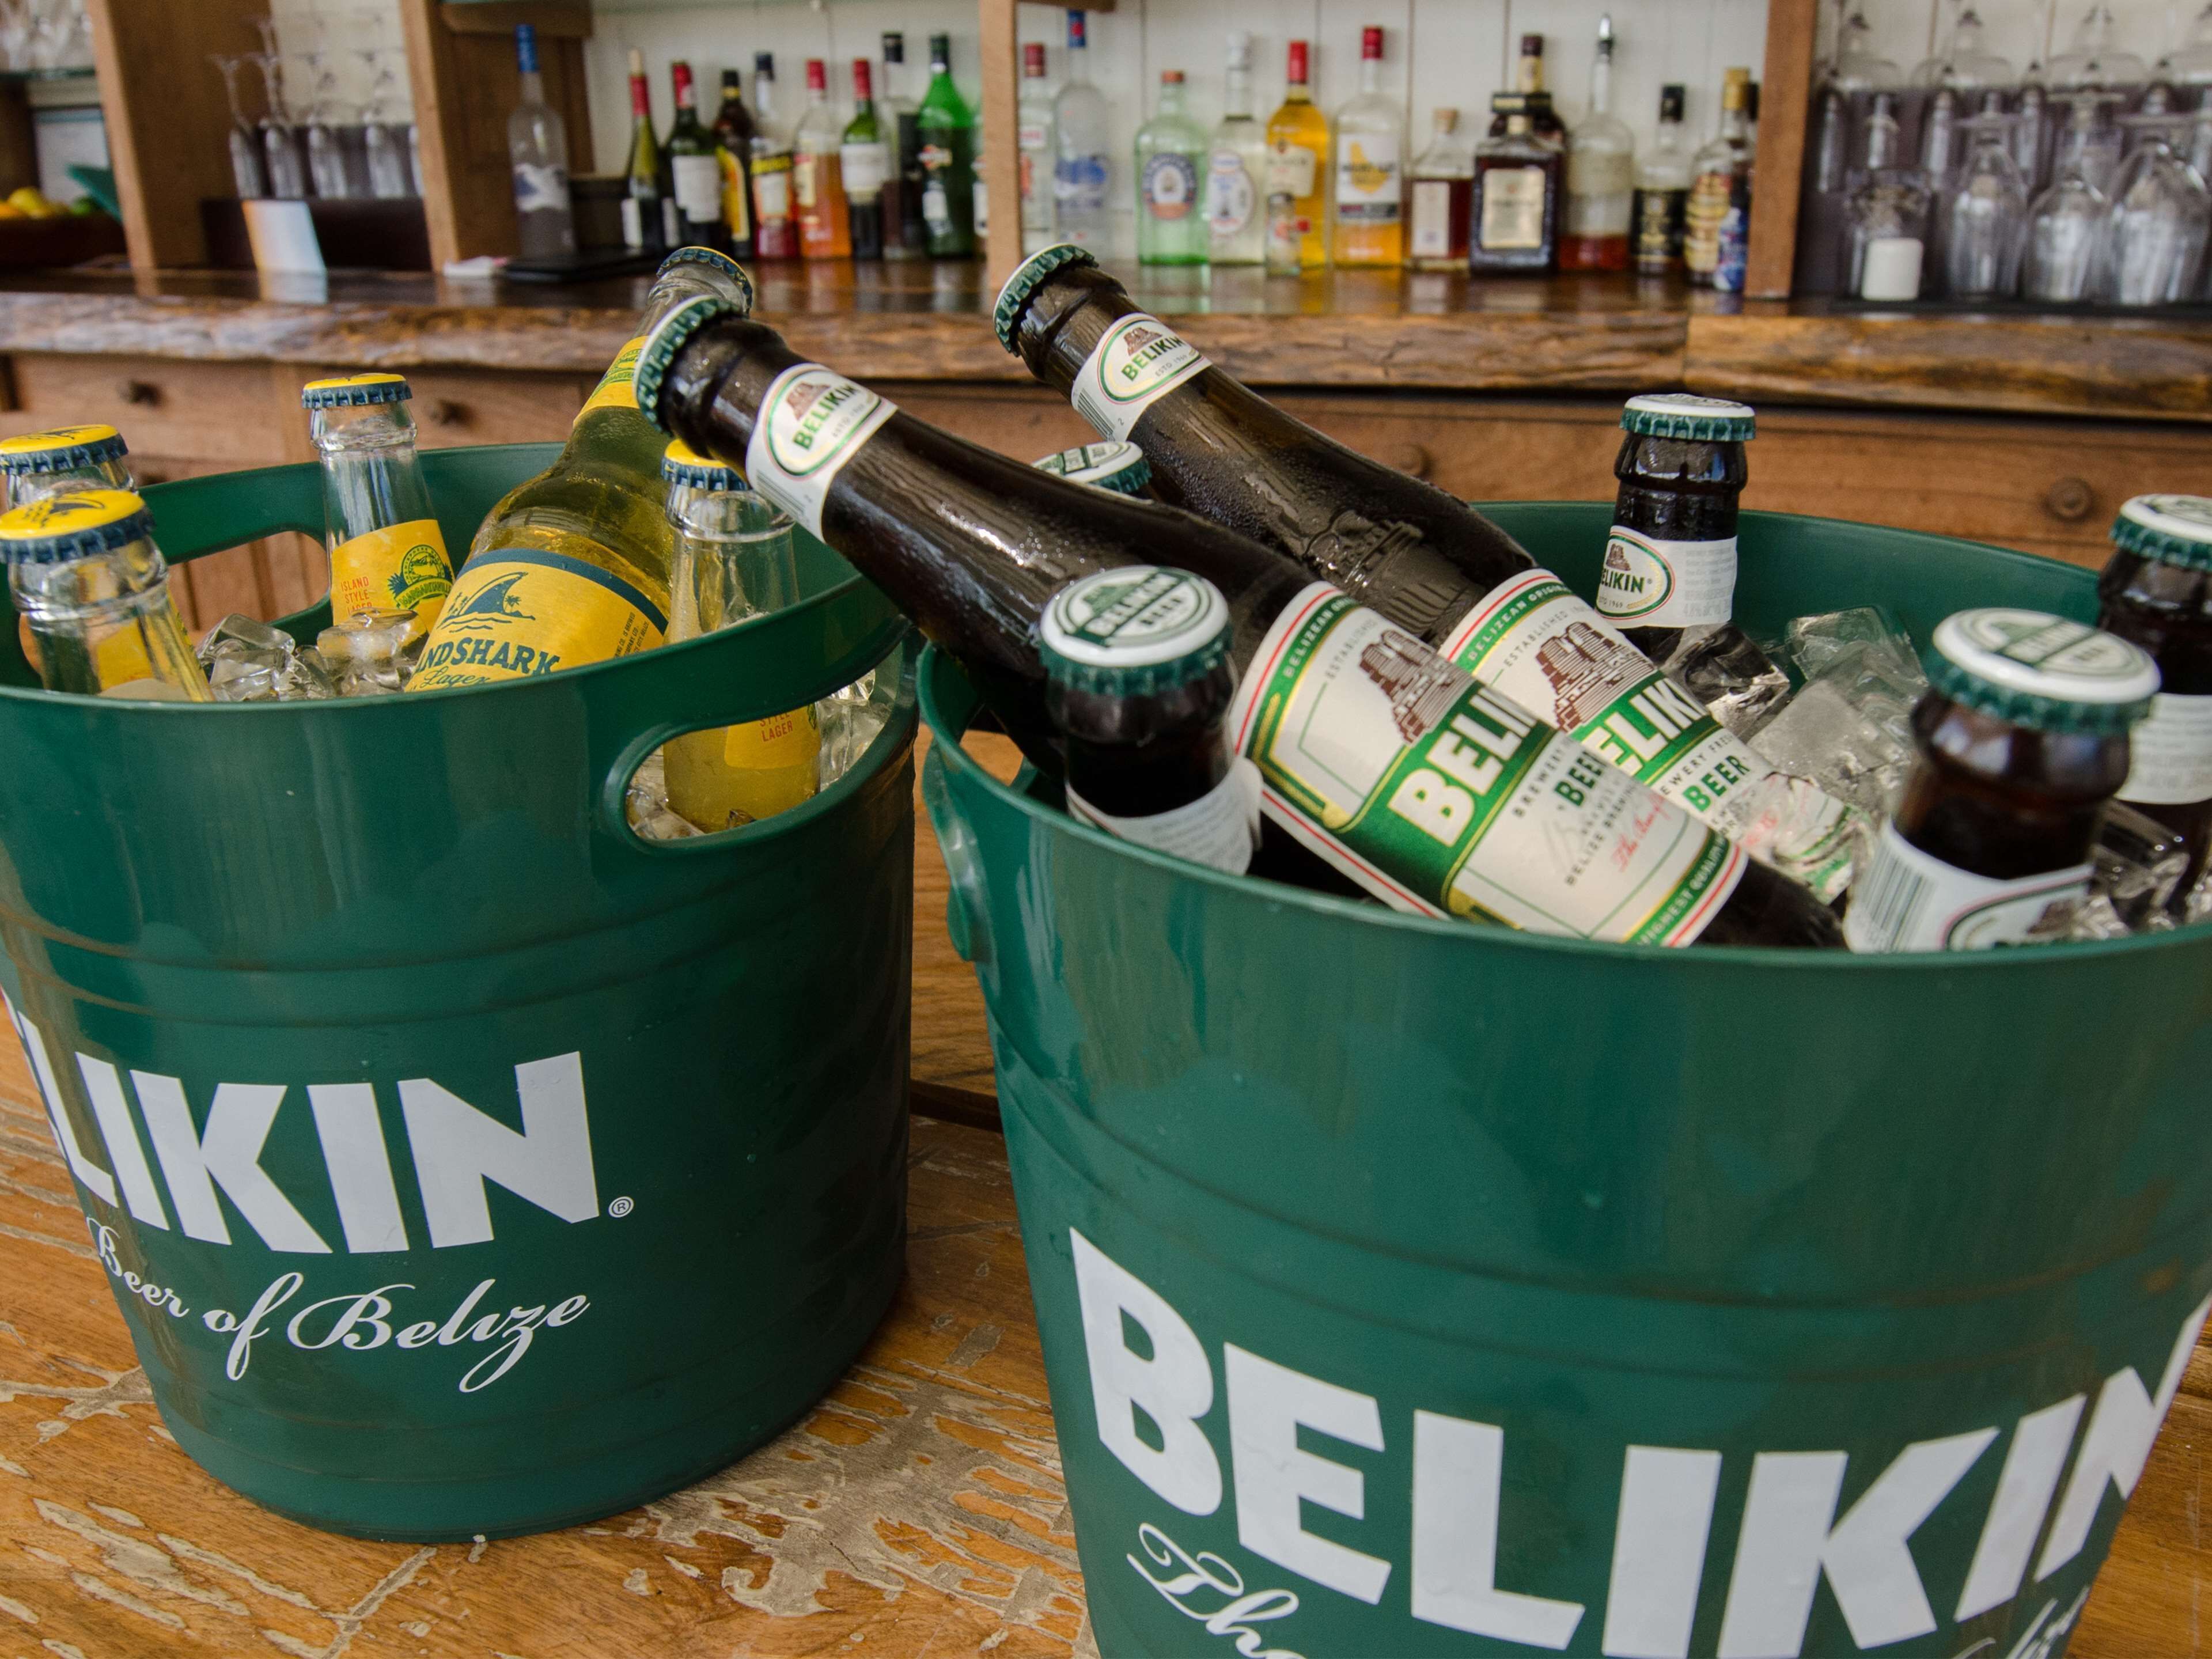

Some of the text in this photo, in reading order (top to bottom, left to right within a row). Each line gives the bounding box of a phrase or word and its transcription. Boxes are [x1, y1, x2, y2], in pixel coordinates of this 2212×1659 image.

[1121, 336, 1185, 382] BELIKIN
[792, 384, 859, 450] BELIKIN
[340, 576, 369, 592] ISLAND
[344, 589, 370, 604] STYLE
[1283, 609, 1334, 679] BELIZEAN
[1468, 600, 1527, 661] BELIZEAN
[1503, 610, 1568, 668] ESTABLISHED
[761, 720, 794, 743] LAGER
[1682, 755, 1752, 813] BEER
[0, 984, 599, 1253] LIKIN
[86, 1216, 591, 1392] Beer of Belize
[1070, 1227, 2212, 1659] BELIKIN
